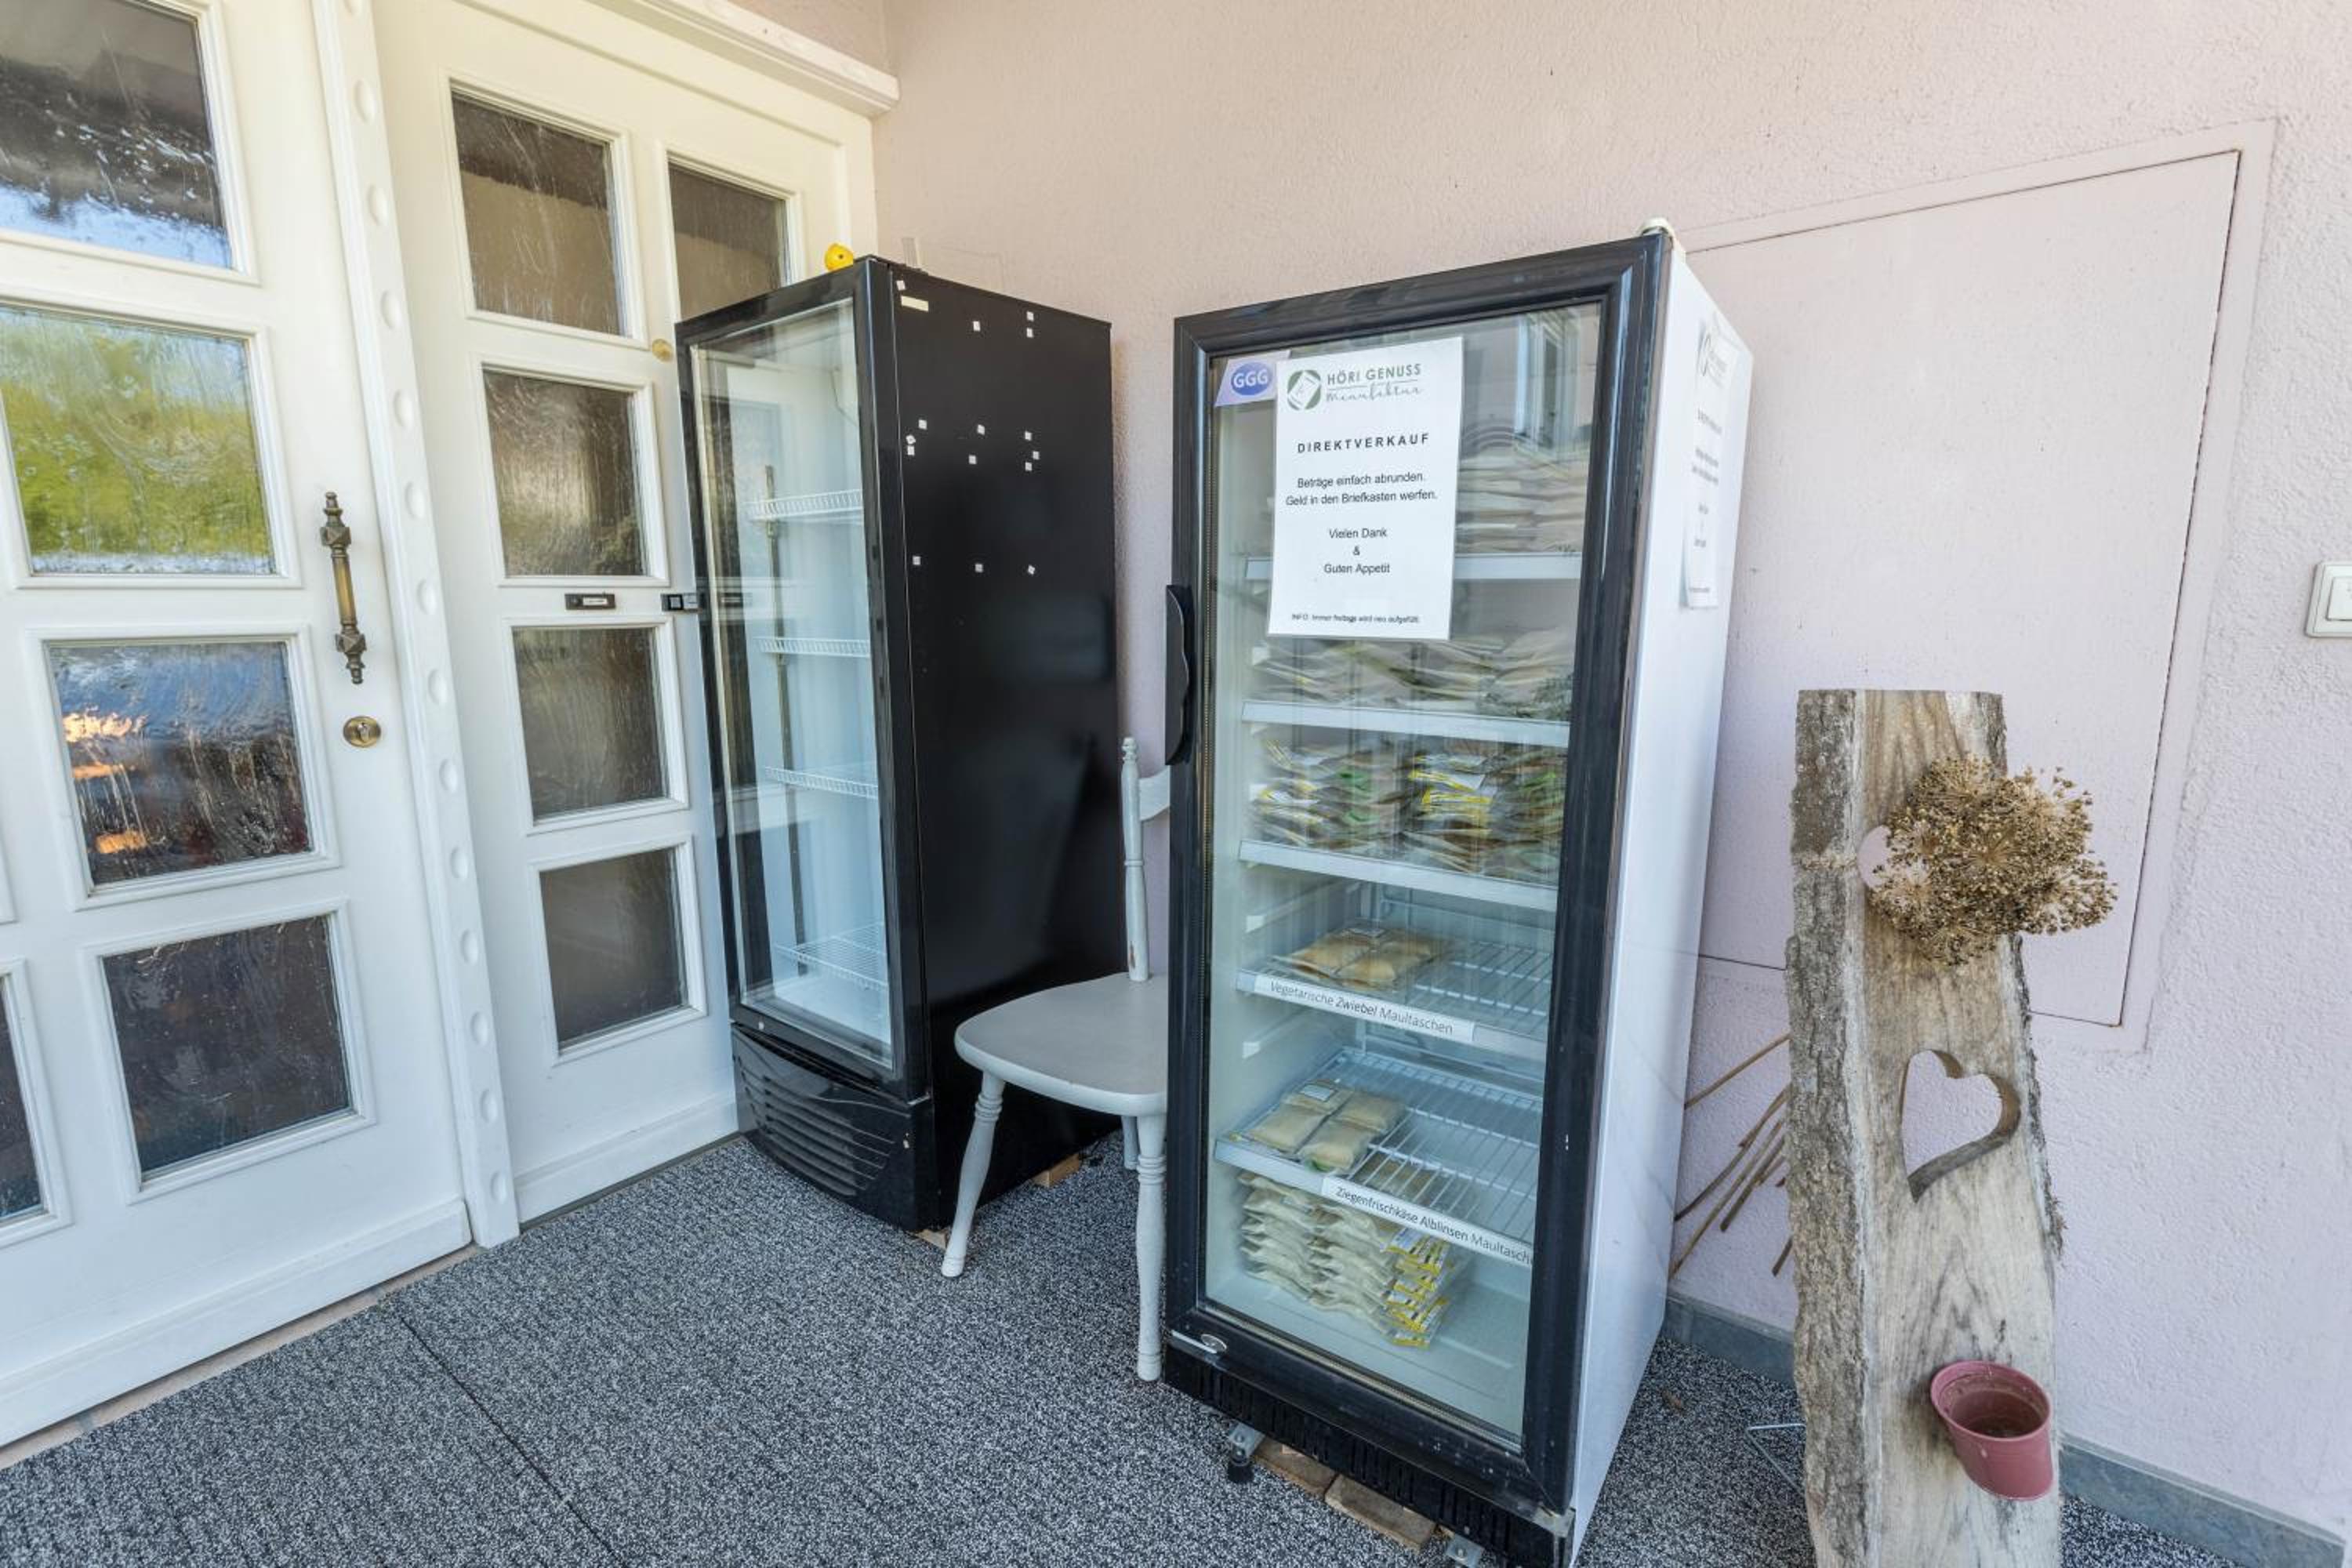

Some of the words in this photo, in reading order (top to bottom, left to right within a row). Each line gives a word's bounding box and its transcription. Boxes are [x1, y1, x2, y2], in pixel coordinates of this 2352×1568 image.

[1232, 368, 1269, 389] GGG
[1327, 372, 1360, 386] HÖRI
[1366, 363, 1421, 380] GENUSS
[1297, 433, 1429, 453] DIREKTVERKAUF
[1298, 477, 1333, 489] Beträge
[1336, 474, 1371, 485] einfach
[1374, 471, 1425, 484] abrunden.
[1286, 494, 1308, 506] Geld
[1311, 493, 1318, 504] in
[1321, 492, 1338, 504] den
[1341, 490, 1396, 503] Briefkasten
[1399, 489, 1436, 500] werfen.
[1329, 528, 1359, 539] Vielen
[1362, 527, 1387, 538] Dank
[1352, 546, 1360, 556] &
[1324, 564, 1352, 574] Guten
[1355, 563, 1390, 575] Appetit
[1270, 981, 1334, 1006] Vegetarische
[1335, 998, 1377, 1016] Zwiebel
[1380, 1007, 1453, 1033] Maultaschen
[1336, 1187, 1418, 1224] Ziegenfrischkäse
[1420, 1215, 1468, 1242] Alblinsen
